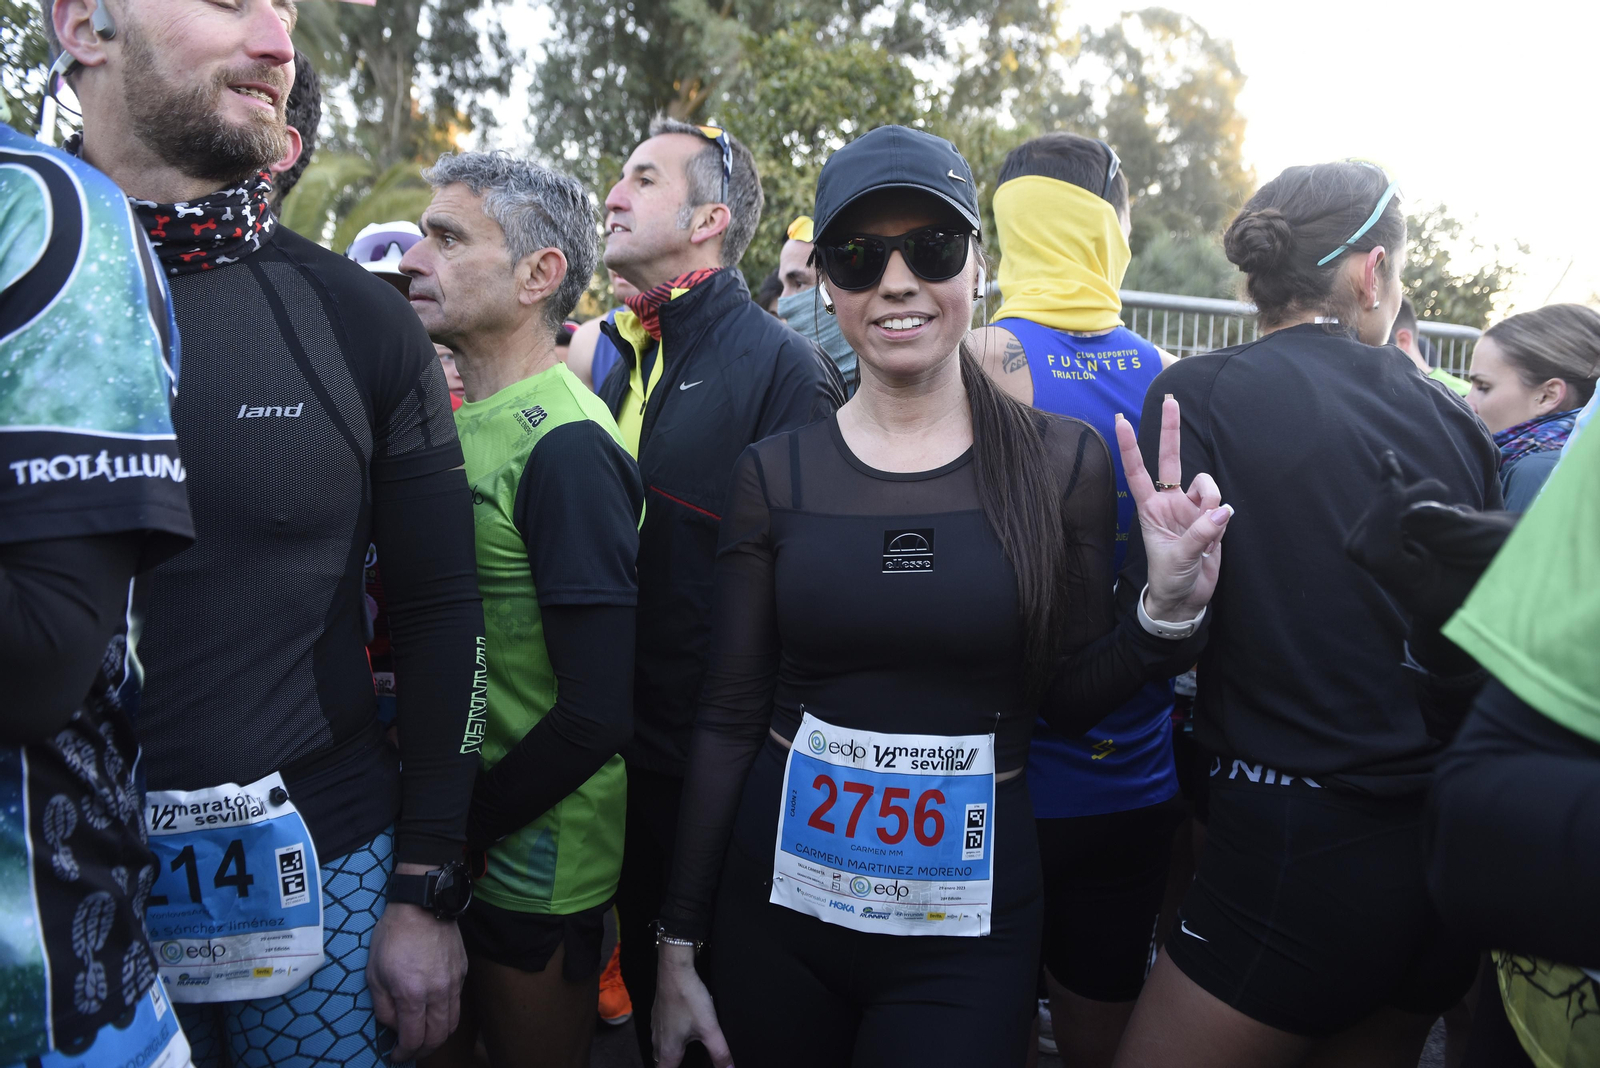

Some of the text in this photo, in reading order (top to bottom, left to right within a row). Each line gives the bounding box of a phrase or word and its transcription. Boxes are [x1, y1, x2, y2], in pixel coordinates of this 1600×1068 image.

[1047, 354, 1141, 371] FUENTES
[1076, 349, 1138, 360] CLUB DEPORTIVO
[1051, 370, 1096, 380] TRIATLÓN
[237, 403, 303, 419] land
[521, 404, 548, 428] 2023
[9, 449, 187, 486] TROTALLUN
[885, 558, 931, 569] ellesse
[828, 739, 867, 764] edp
[895, 745, 965, 759] maratón
[910, 756, 964, 771] sevilla
[175, 792, 256, 816] maratón
[807, 774, 946, 847] 2756
[195, 804, 262, 826] sevilla
[795, 843, 973, 877] CARMEN MARTINEZ MORENO
[850, 844, 904, 857] CARMEN MM
[874, 880, 910, 901] edp
[829, 899, 855, 914] HOKA
[186, 941, 226, 962] edp
